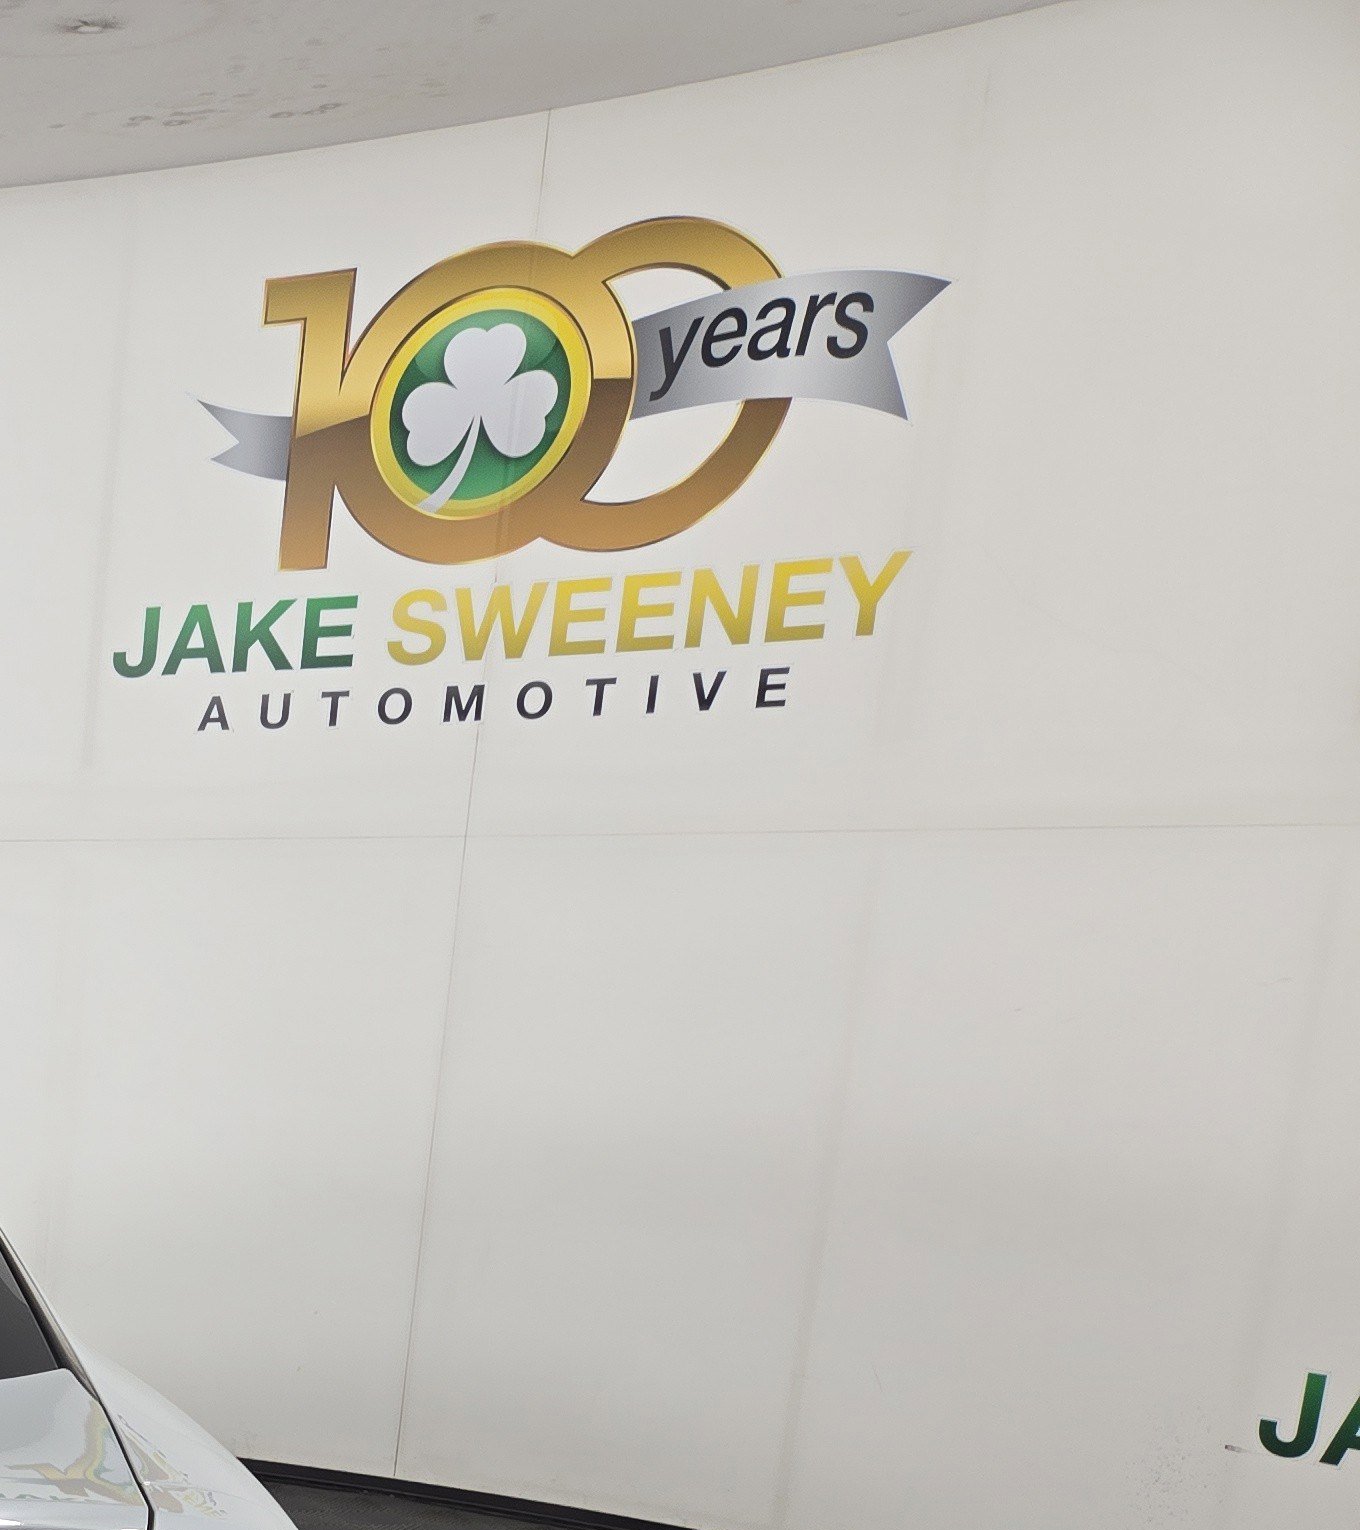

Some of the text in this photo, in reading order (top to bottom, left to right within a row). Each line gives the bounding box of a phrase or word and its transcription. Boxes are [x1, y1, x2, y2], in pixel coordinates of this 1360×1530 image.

[263, 215, 875, 571] 100 years
[113, 551, 912, 678] JAKE SWEENEY
[197, 667, 792, 732] AUTOMOTIVE
